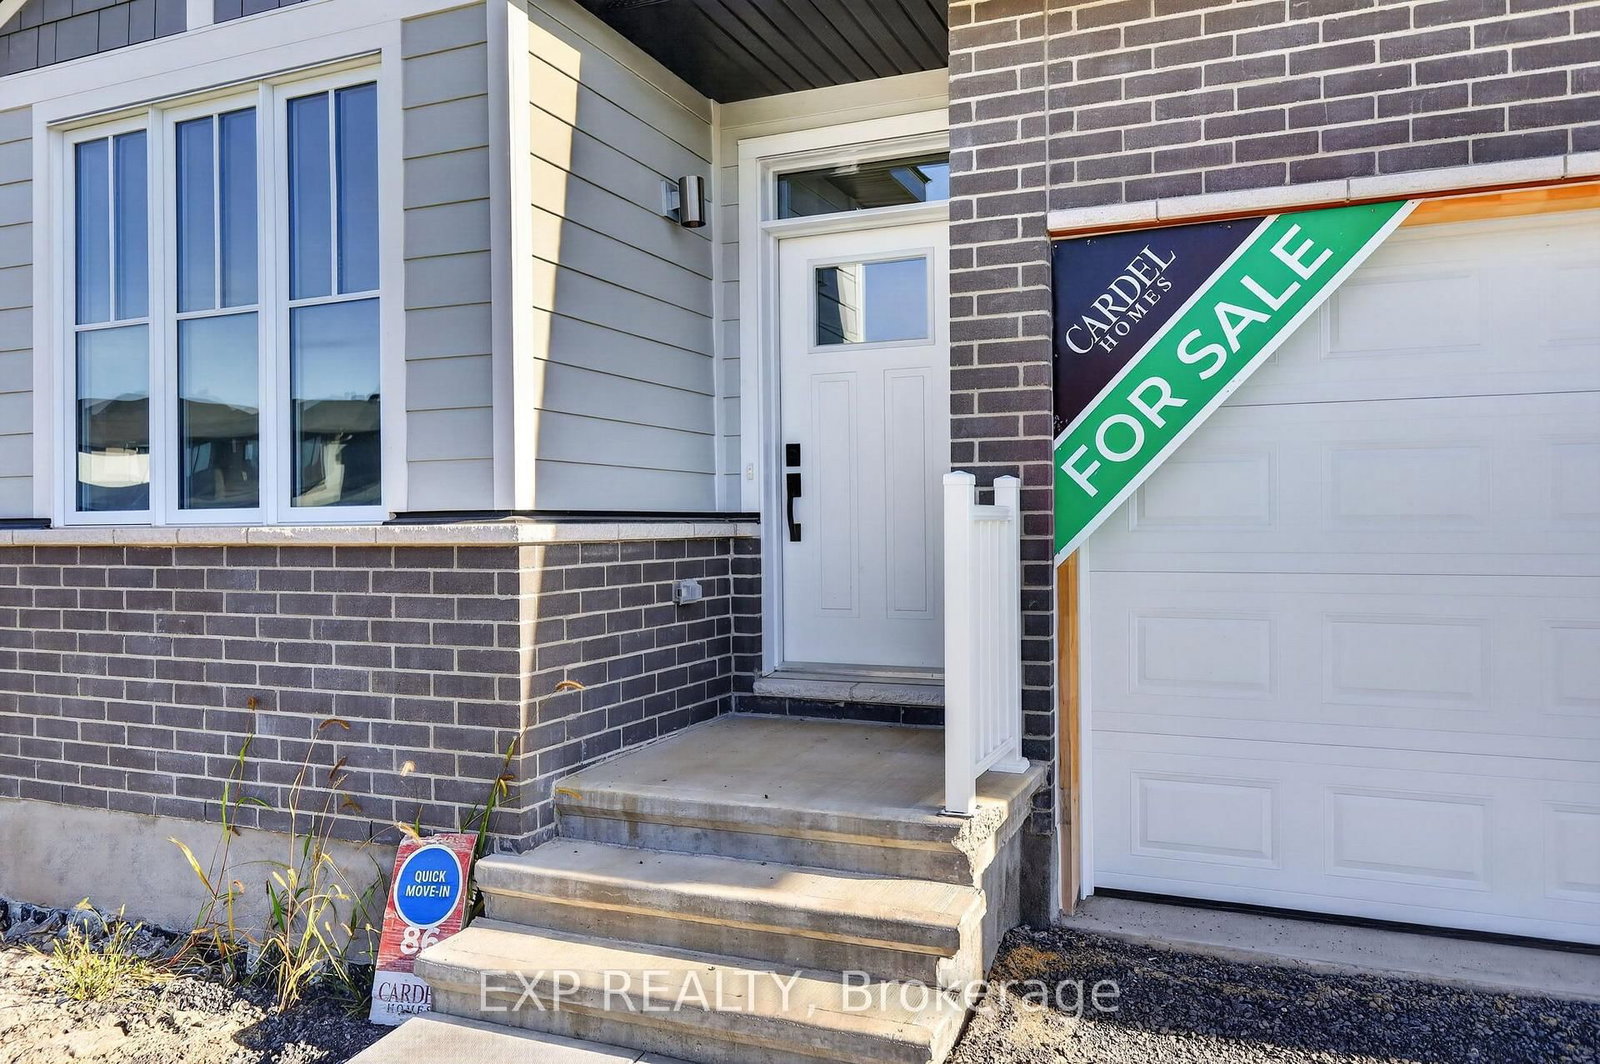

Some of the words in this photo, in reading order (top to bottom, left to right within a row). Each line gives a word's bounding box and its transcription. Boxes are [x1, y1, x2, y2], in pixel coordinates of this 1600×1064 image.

[1065, 245, 1176, 354] CARDEL
[1098, 276, 1172, 353] HOMES
[1060, 376, 1188, 498] FOR
[1176, 223, 1334, 381] SALE
[405, 885, 451, 898] MOVE-IN
[414, 870, 447, 884] QUICK
[379, 981, 431, 1005] CARDE
